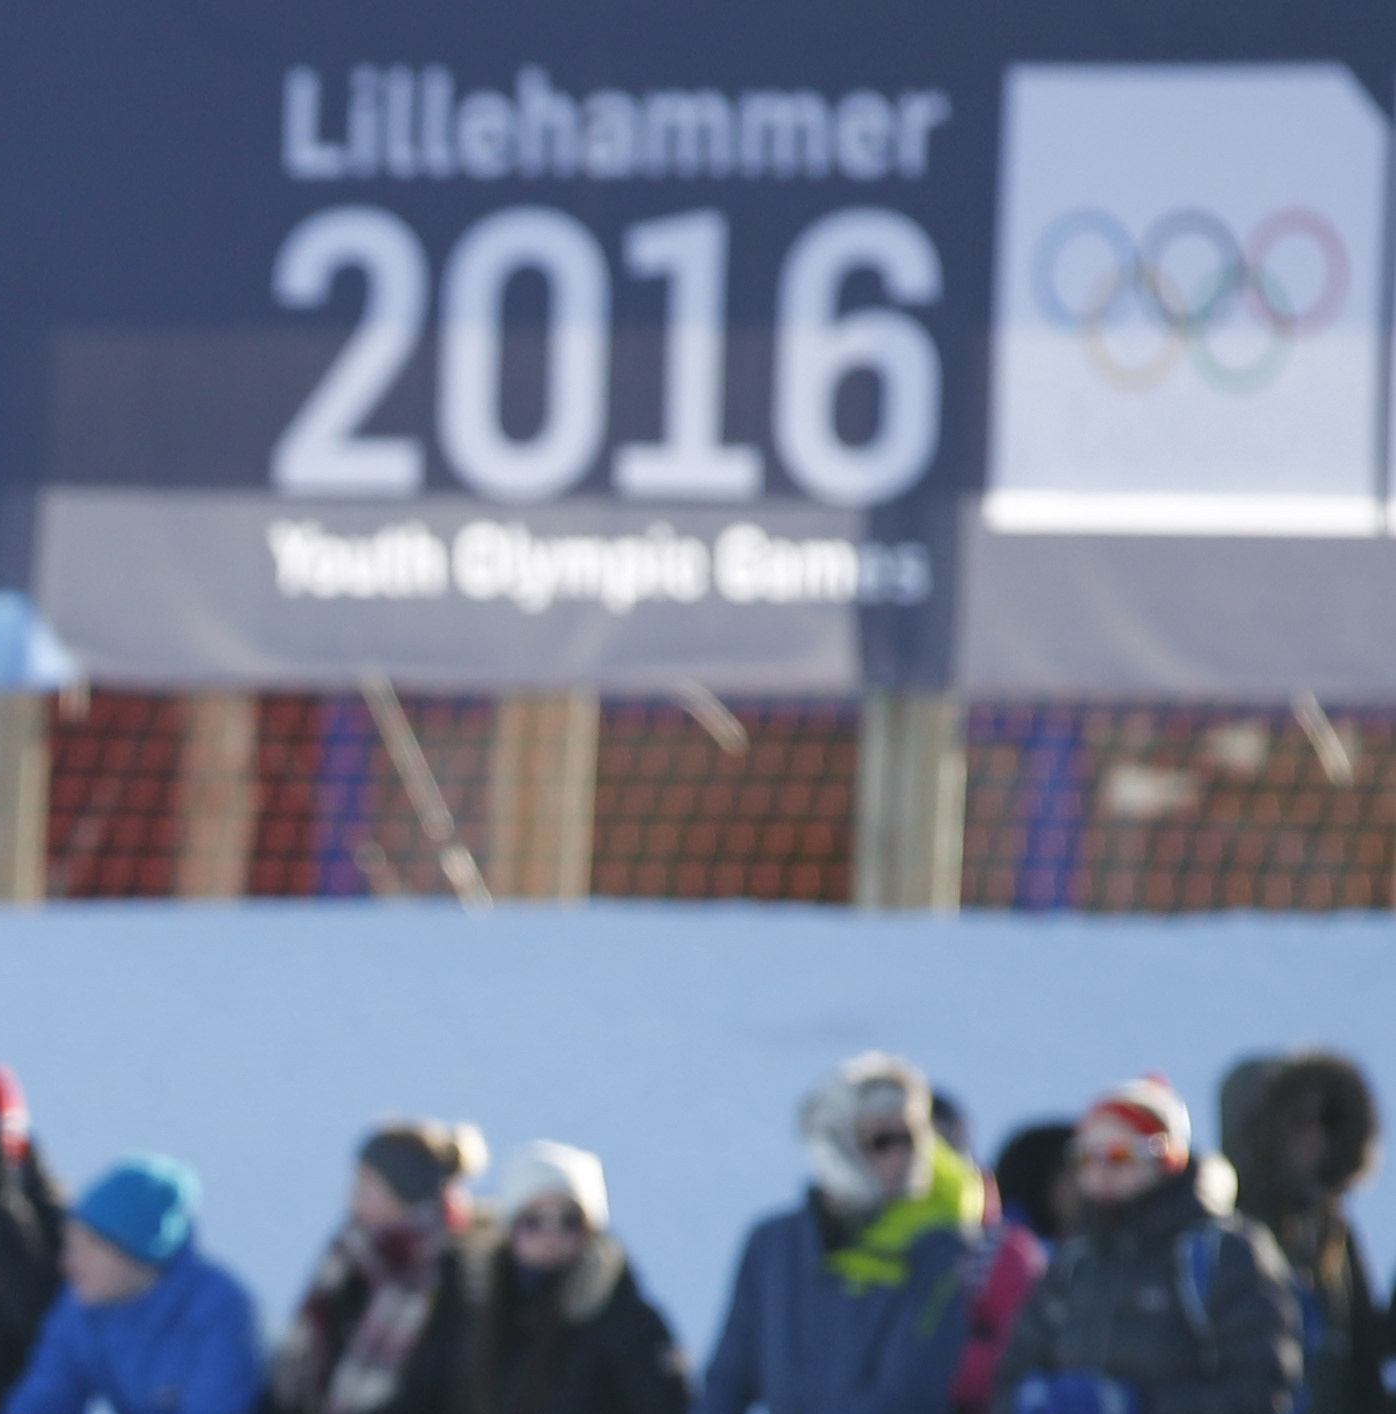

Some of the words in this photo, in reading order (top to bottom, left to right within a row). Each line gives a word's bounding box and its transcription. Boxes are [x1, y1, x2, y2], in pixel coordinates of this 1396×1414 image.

[281, 64, 950, 180] Lillehammer
[270, 207, 946, 506] 2016
[266, 518, 451, 600] Youth
[451, 520, 716, 616] Olympic
[716, 522, 934, 605] Games
